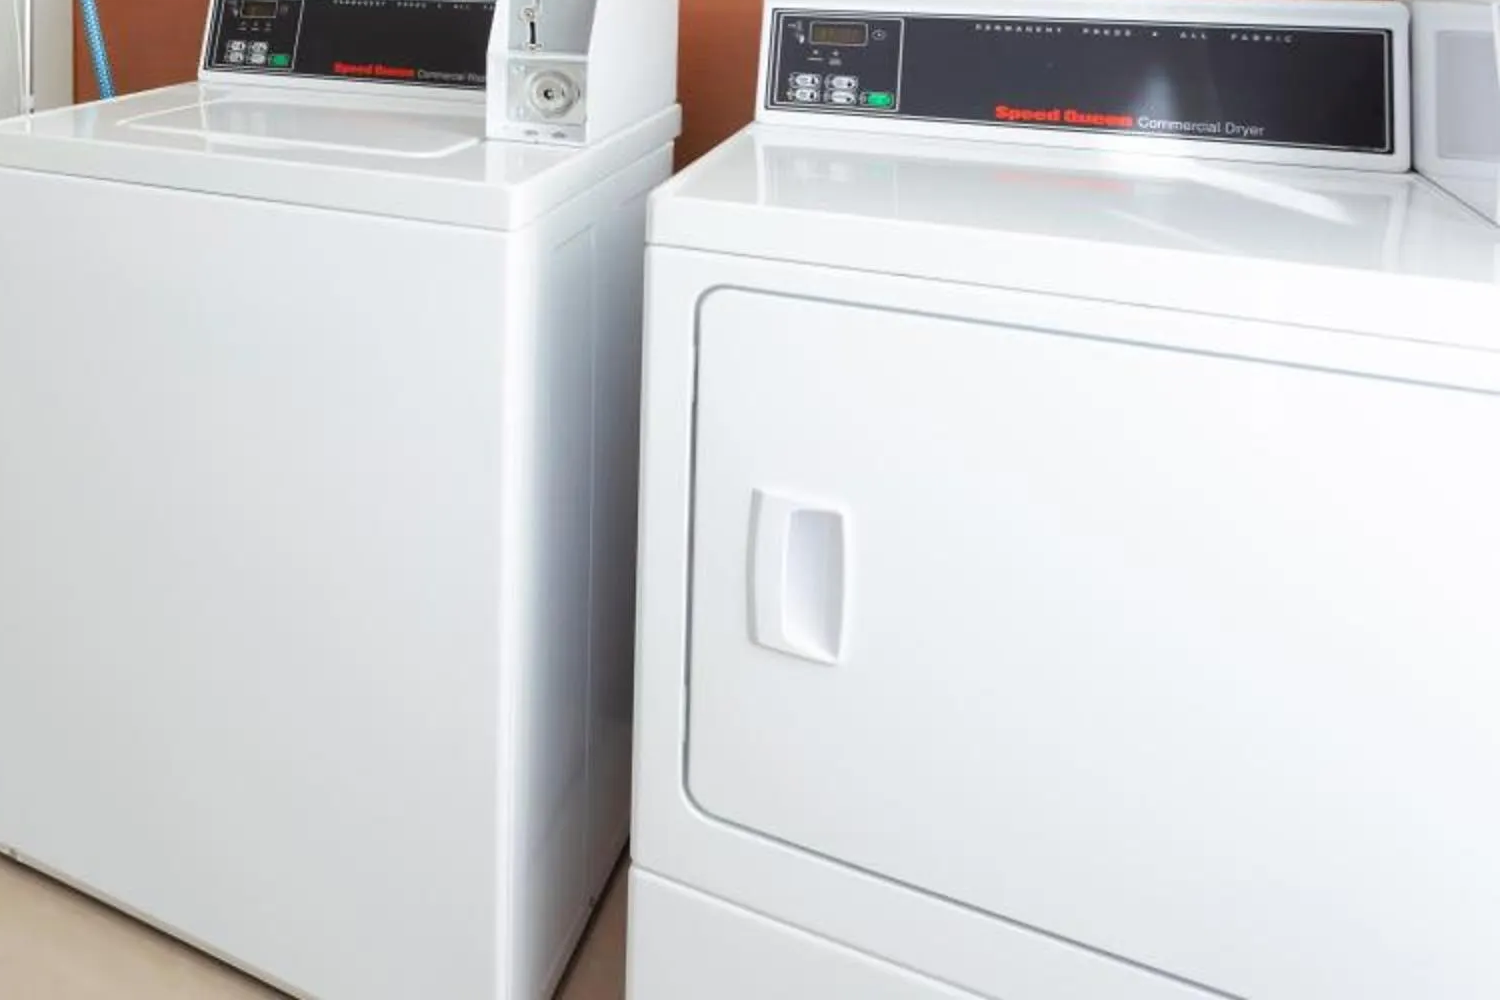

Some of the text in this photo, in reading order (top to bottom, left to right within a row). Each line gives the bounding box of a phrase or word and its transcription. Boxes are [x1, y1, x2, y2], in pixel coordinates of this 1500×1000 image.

[995, 105, 1264, 137] Speed Queen Commercial Dryer
